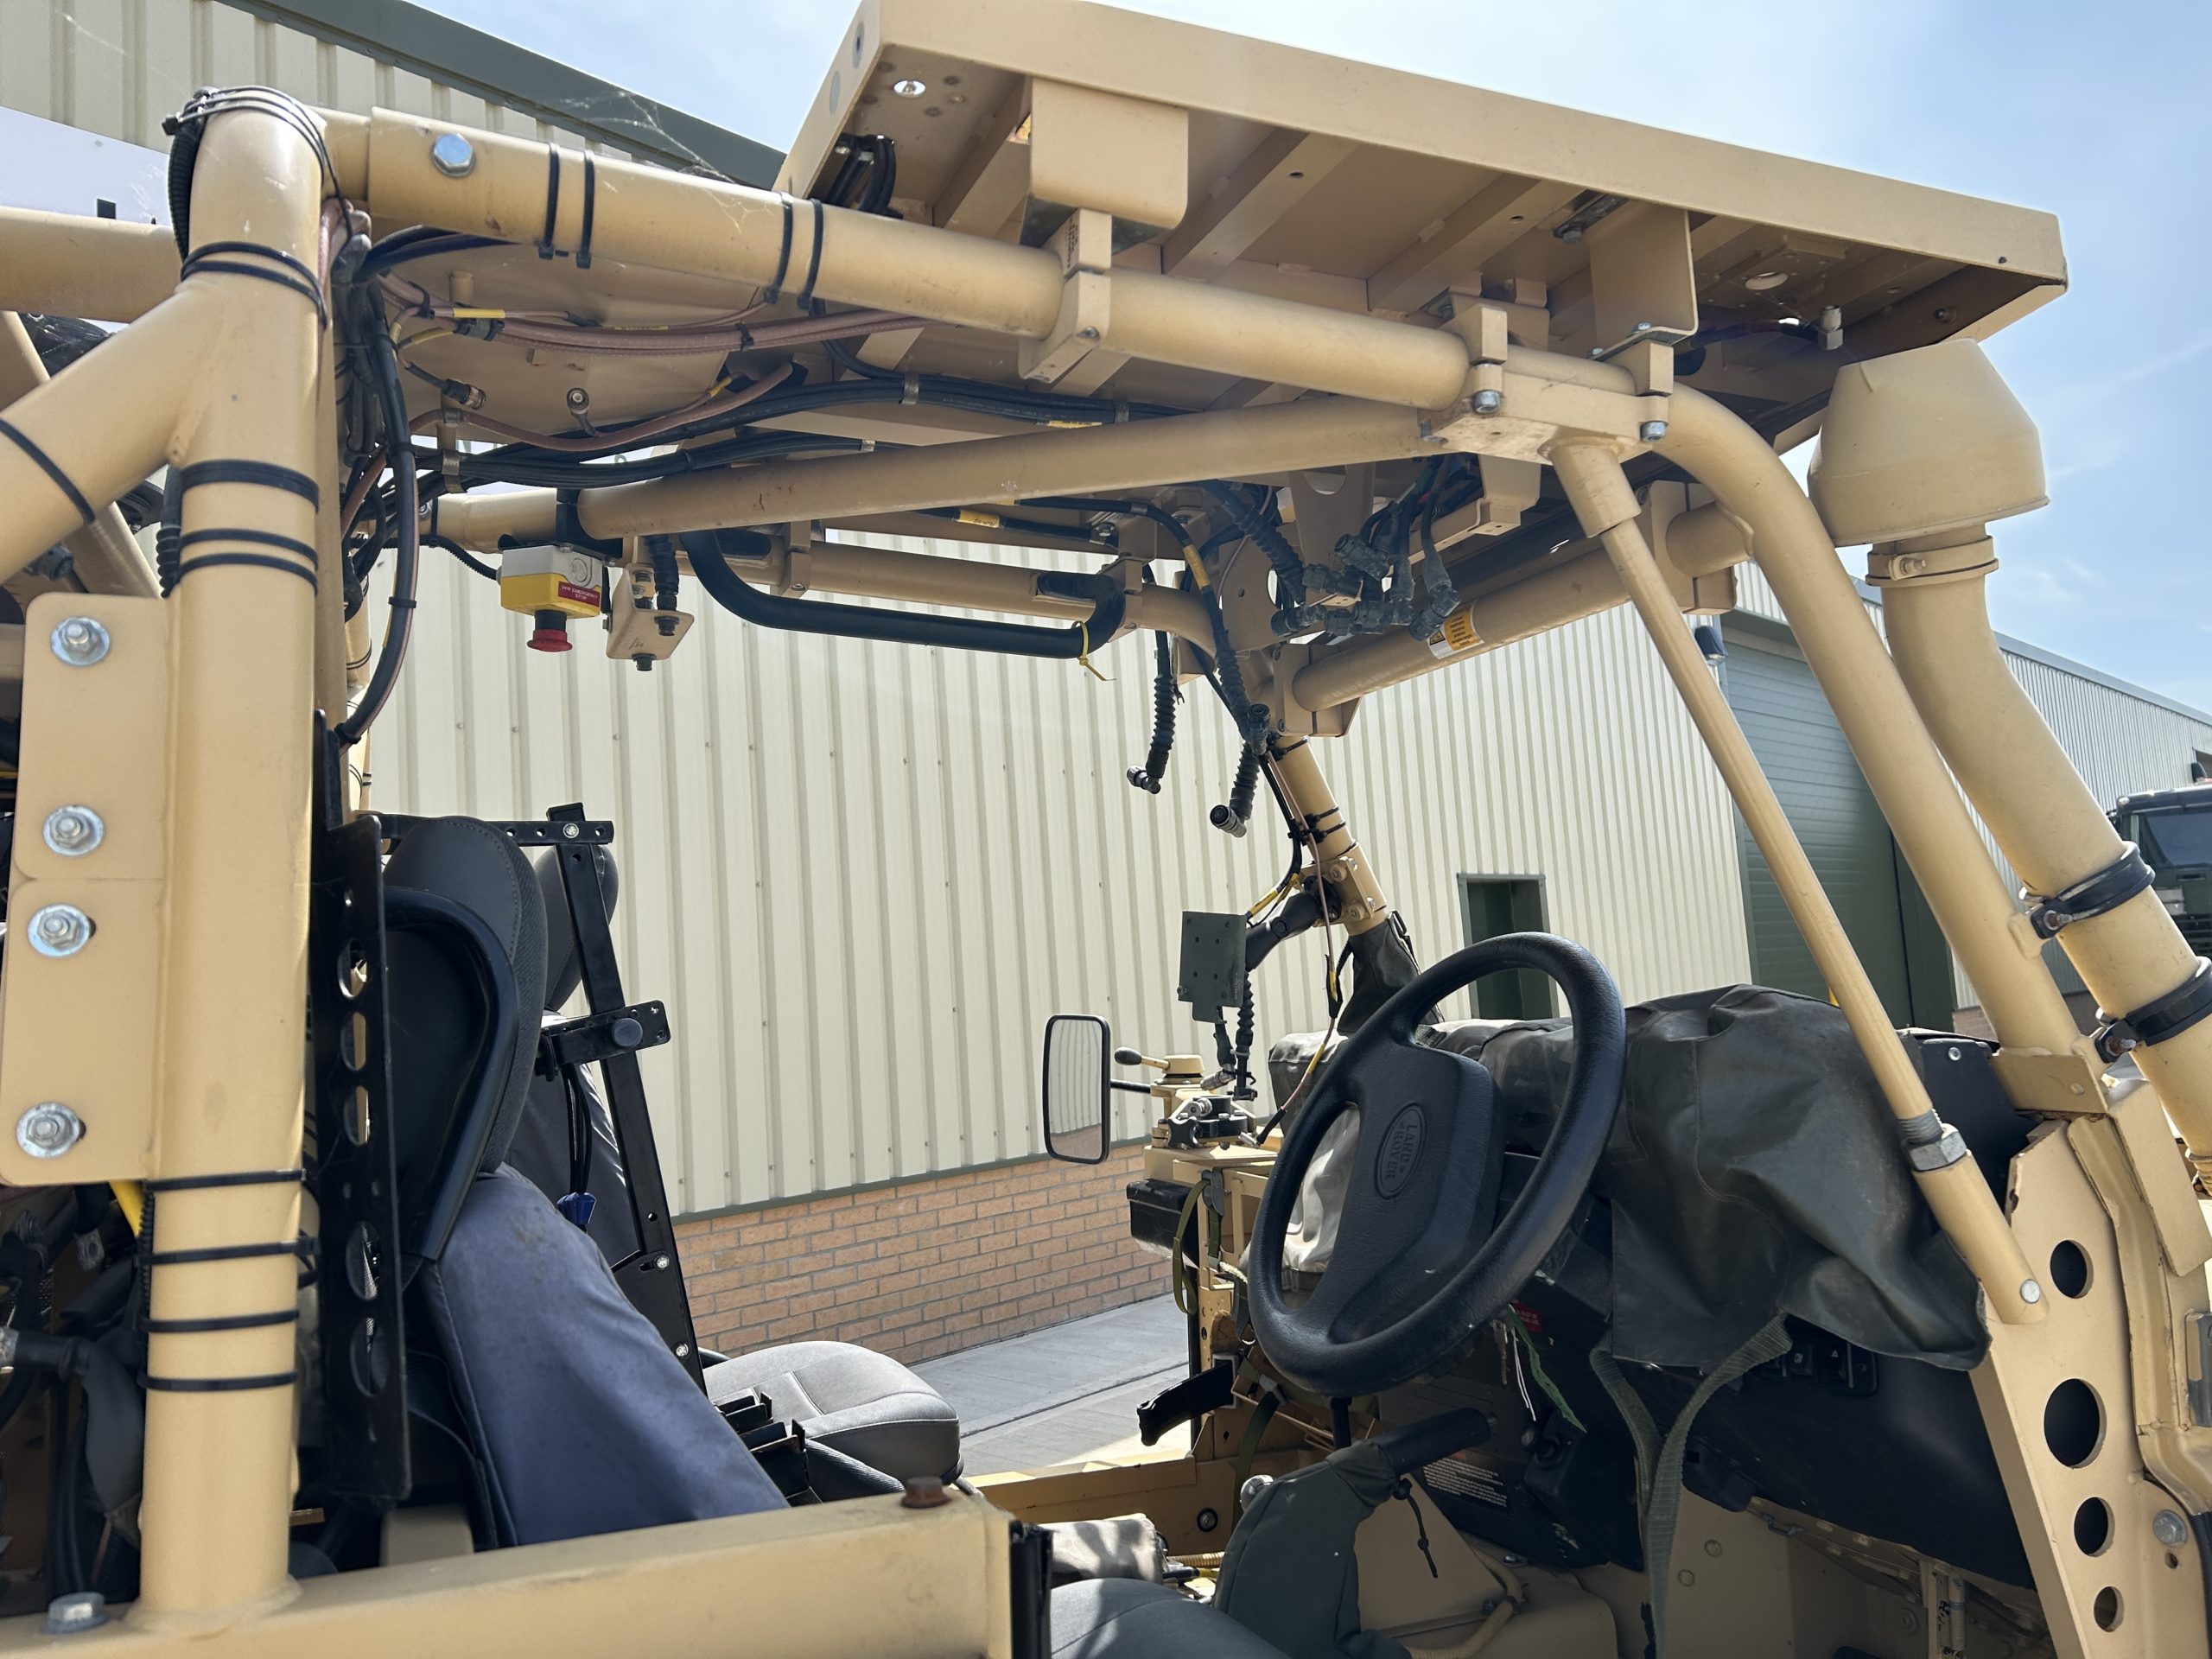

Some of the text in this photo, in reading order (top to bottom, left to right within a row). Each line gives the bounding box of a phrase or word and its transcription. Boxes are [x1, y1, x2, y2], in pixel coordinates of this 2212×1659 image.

[571, 588, 598, 599] EMERGENCY
[1384, 1130, 1404, 1180] ROVER
[1401, 1124, 1418, 1162] LAND
